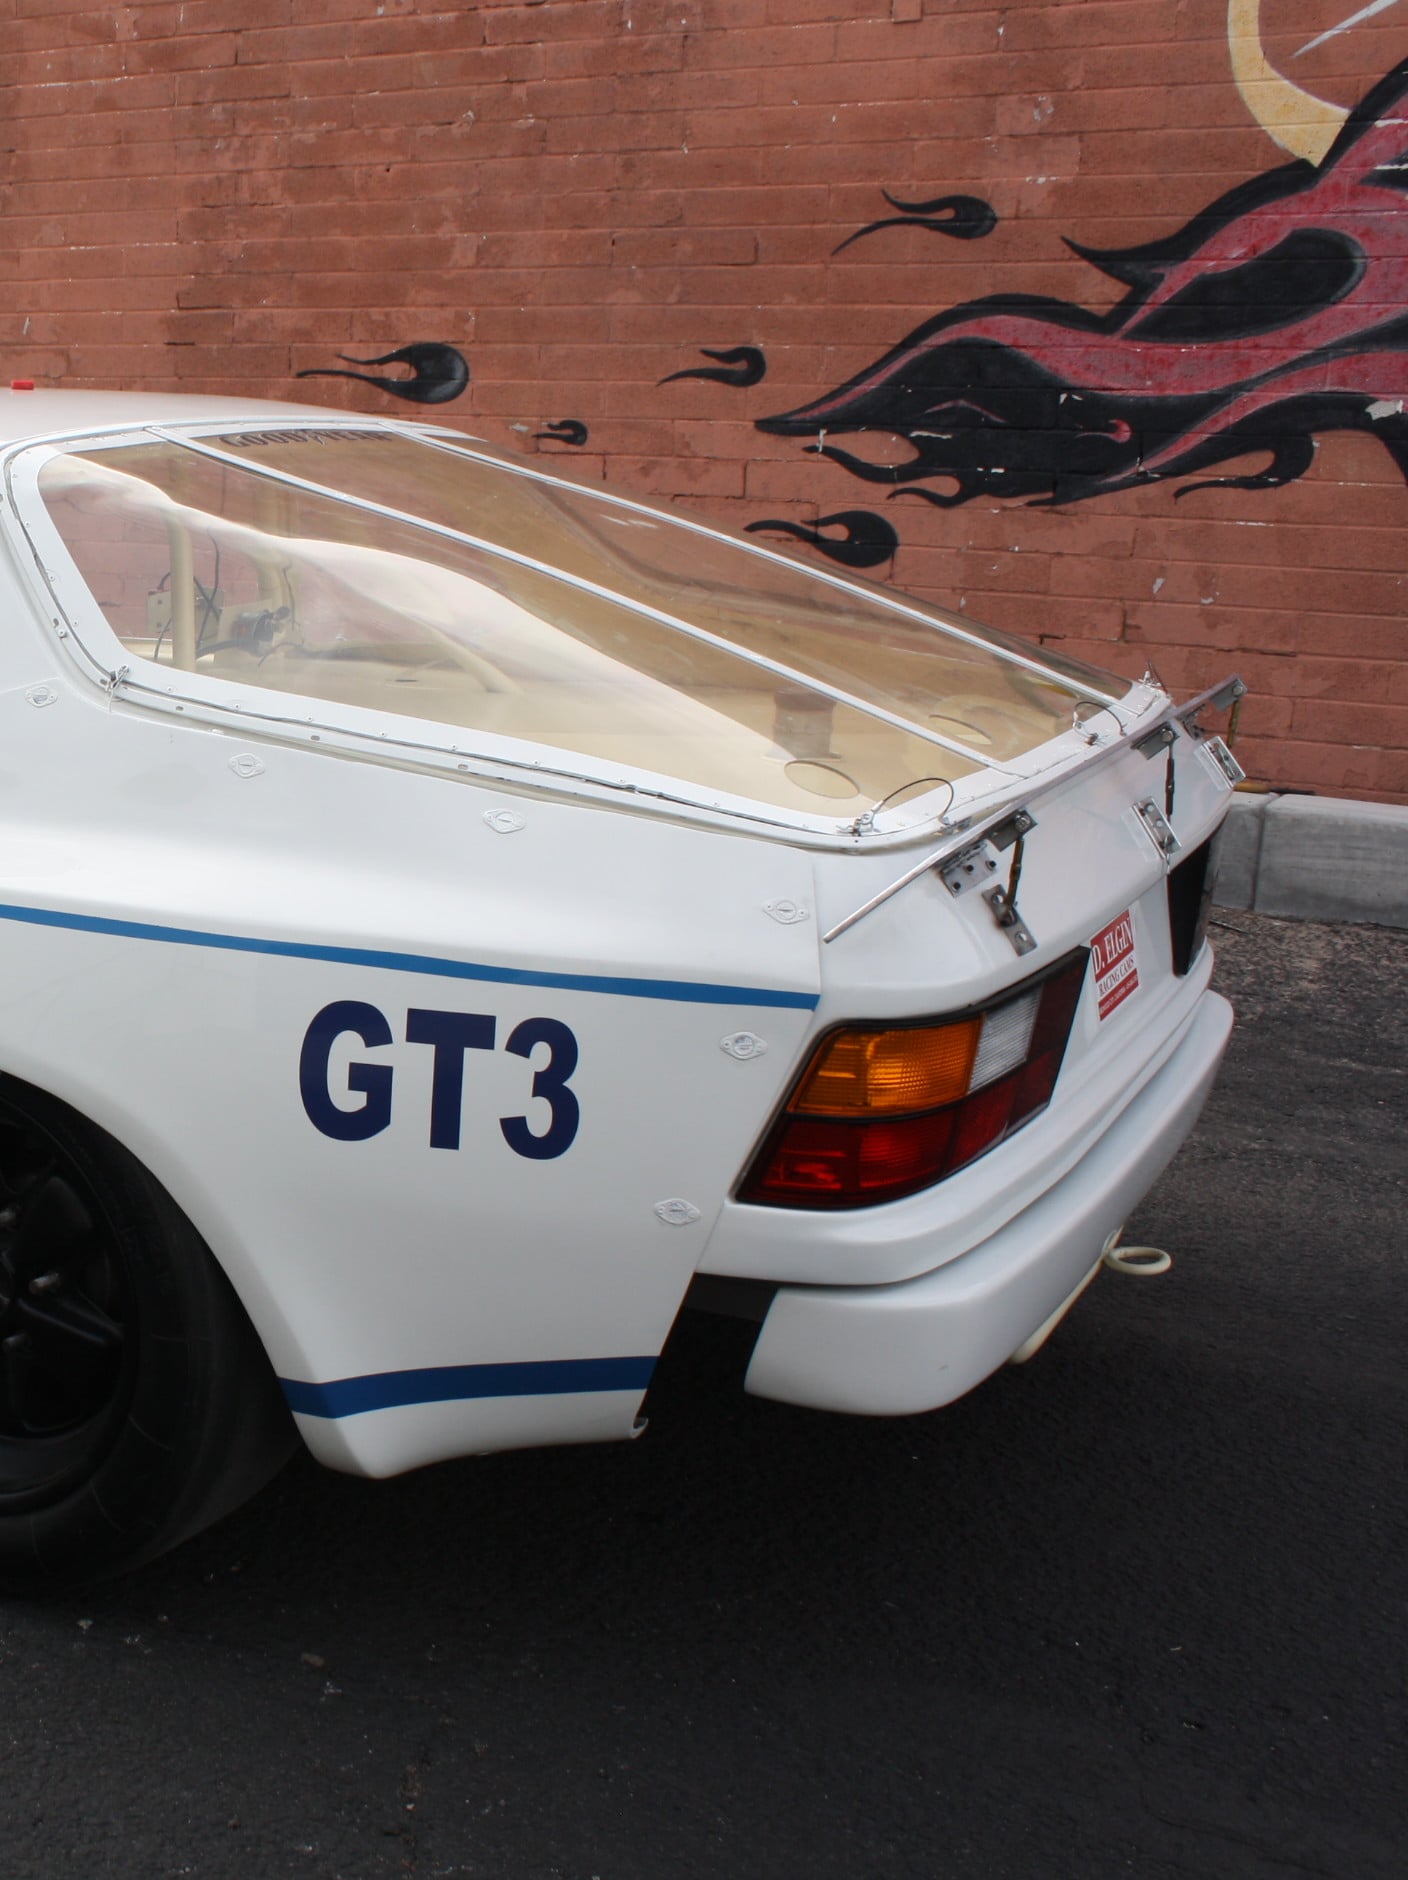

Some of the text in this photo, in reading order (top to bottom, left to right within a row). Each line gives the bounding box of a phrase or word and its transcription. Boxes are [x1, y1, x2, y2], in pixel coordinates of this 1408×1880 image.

[1092, 917, 1134, 975] D. ELGIN
[1098, 970, 1120, 996] RACING
[1119, 955, 1134, 979] CAMS
[299, 1000, 580, 1160] GT3
